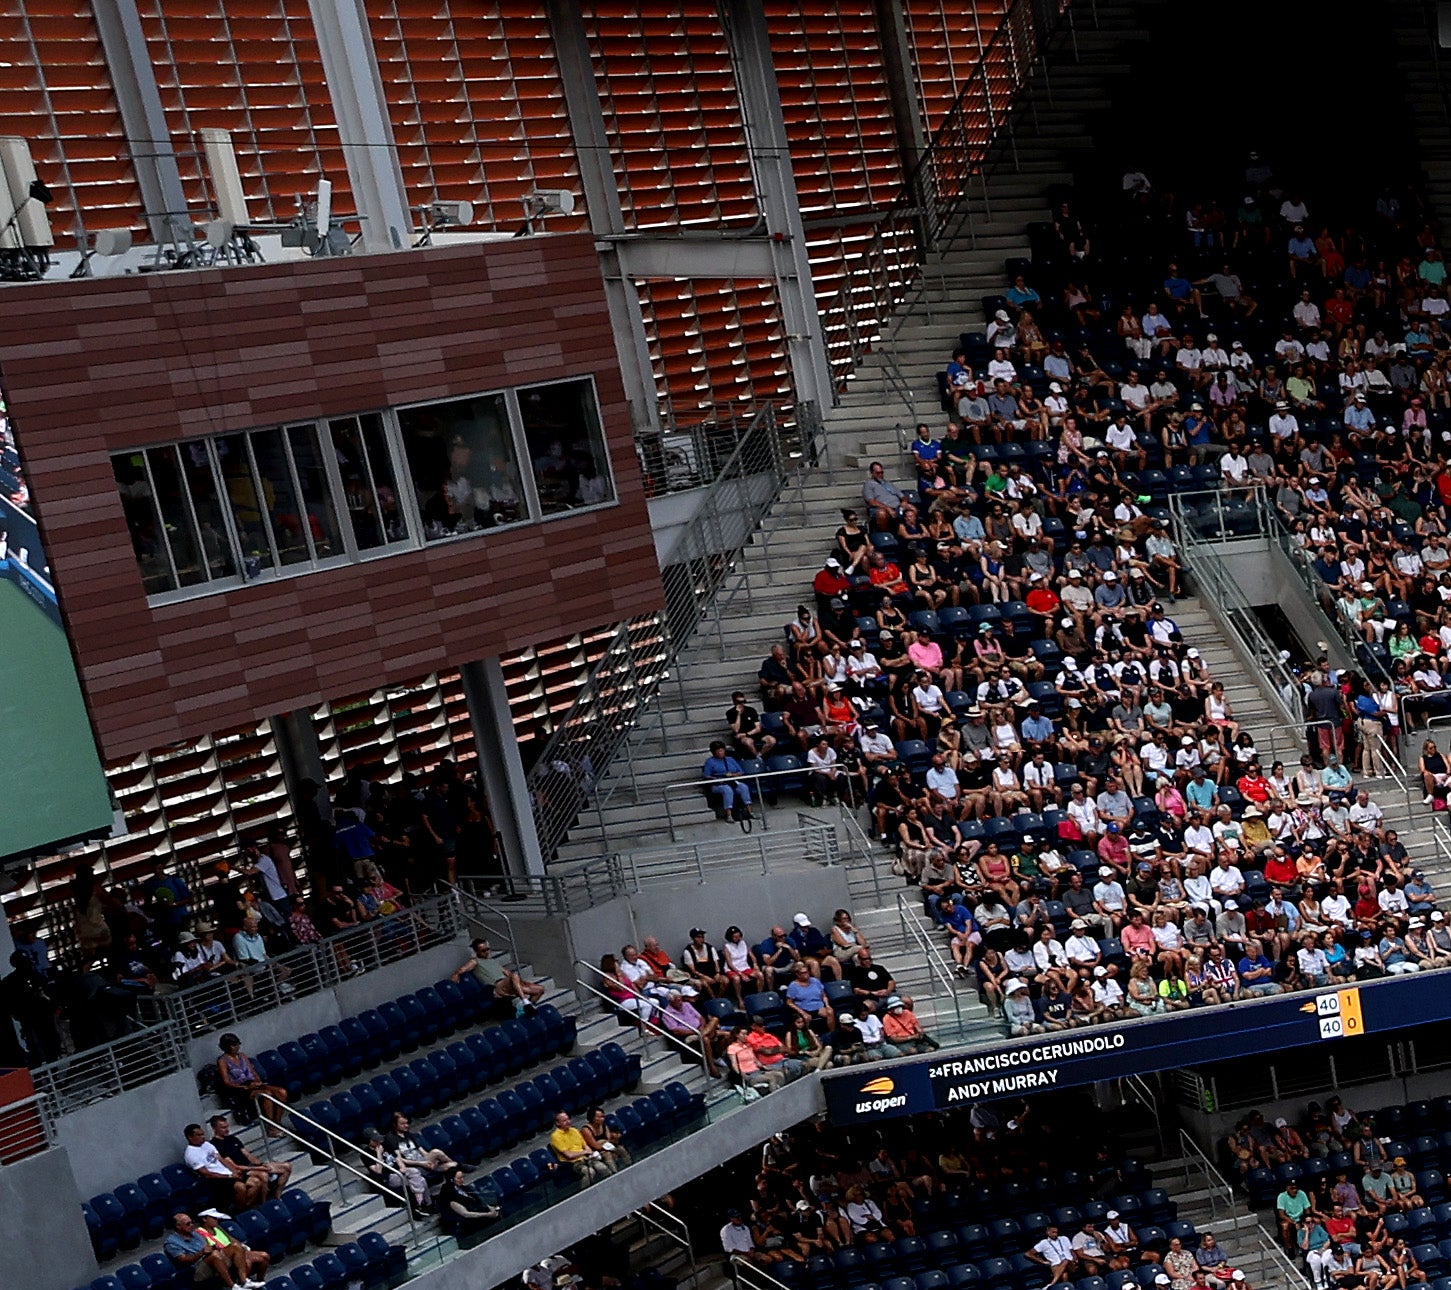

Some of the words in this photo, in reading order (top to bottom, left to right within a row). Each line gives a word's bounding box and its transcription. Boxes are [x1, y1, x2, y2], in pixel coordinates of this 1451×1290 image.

[1319, 998, 1338, 1011] 40
[1322, 1020, 1341, 1034] 40
[1347, 1017, 1357, 1029] 0
[943, 1051, 1031, 1078] FRANCISCO
[1032, 1034, 1125, 1061] CERUNDOLO
[947, 1080, 991, 1102] ANDY
[993, 1069, 1059, 1096] MURRAY
